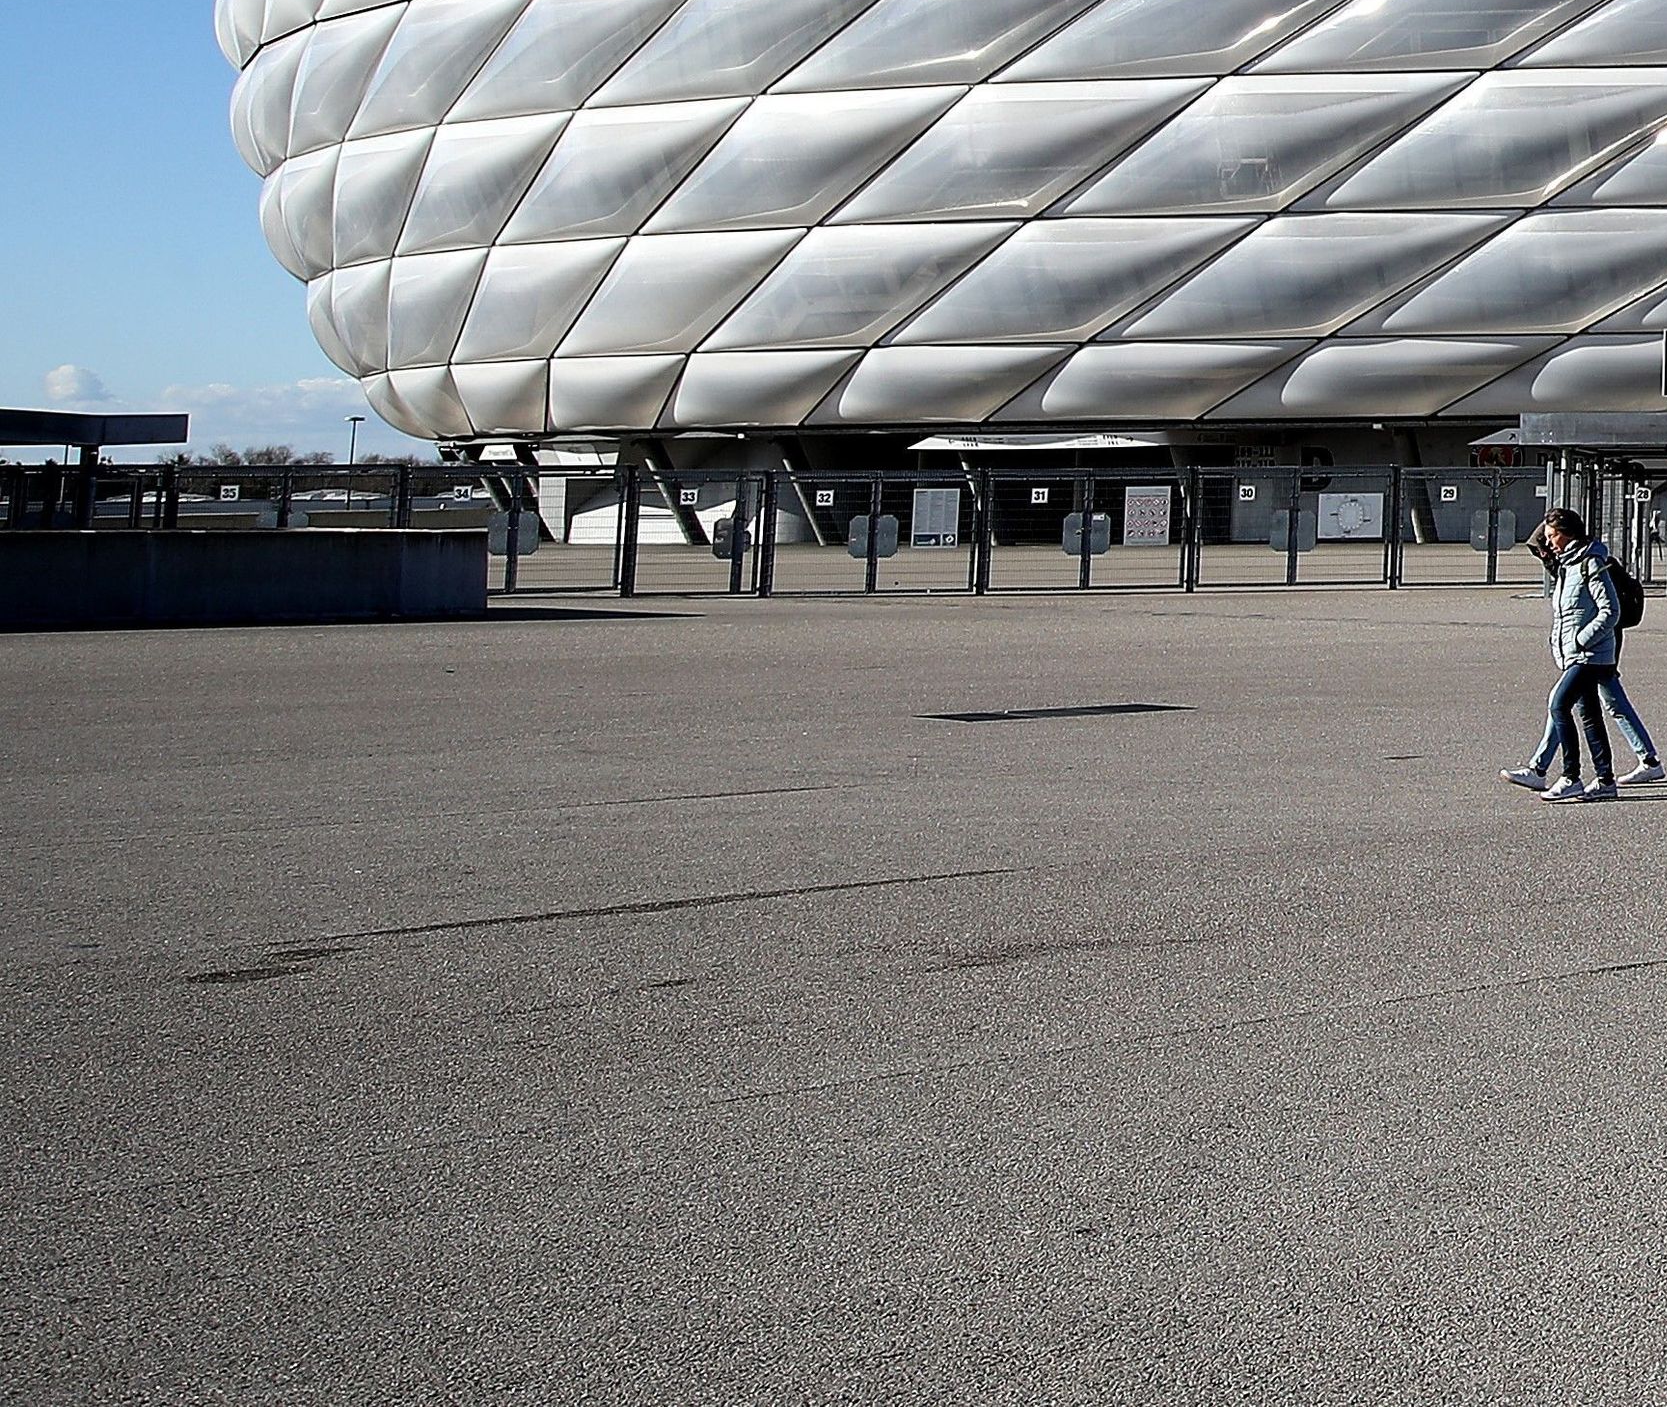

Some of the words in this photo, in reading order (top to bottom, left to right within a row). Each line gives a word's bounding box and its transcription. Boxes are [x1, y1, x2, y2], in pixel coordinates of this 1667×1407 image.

[222, 487, 236, 499] 35
[454, 487, 469, 499] 34
[681, 491, 695, 502] 33
[818, 492, 831, 503] 32
[1033, 490, 1046, 501] 31
[1241, 488, 1254, 499] 30
[1443, 488, 1455, 499] 29
[1637, 489, 1649, 499] 28
